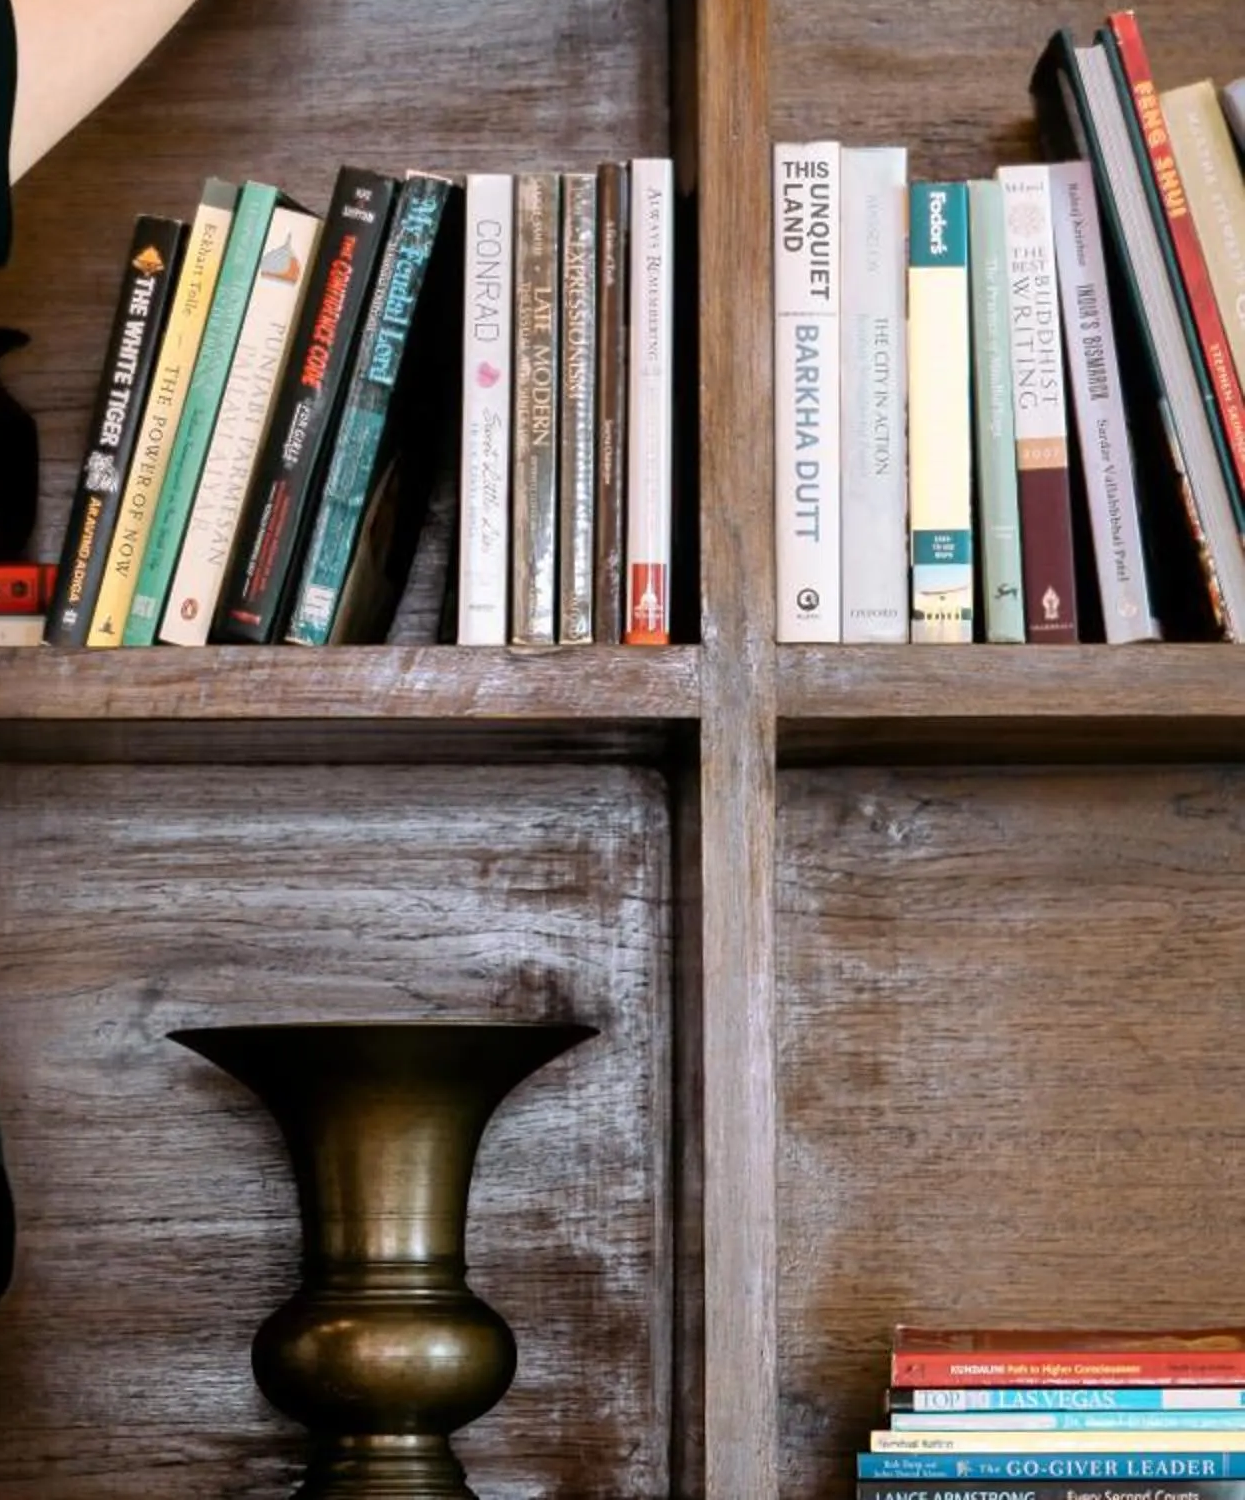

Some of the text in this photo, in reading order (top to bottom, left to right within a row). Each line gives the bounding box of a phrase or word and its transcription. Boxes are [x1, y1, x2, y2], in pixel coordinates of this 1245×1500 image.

[782, 161, 830, 178] THIS
[1132, 79, 1187, 218] FENG SHUI
[194, 222, 218, 276] Eckhart
[402, 195, 437, 237] My
[782, 182, 805, 253] LAND
[809, 182, 831, 301] UNQUIET
[929, 190, 948, 256] Fodor's
[1011, 247, 1046, 259] THE
[182, 280, 203, 318] Tolle
[382, 240, 432, 326] Feudal
[474, 219, 502, 343] CONRAD
[646, 188, 662, 361] ALWAYS REMEMBERING
[1011, 261, 1046, 273] BEST
[368, 325, 406, 386] Lord
[568, 242, 586, 400] EXPRESSIONISM
[1011, 277, 1039, 411] WRITING
[1035, 275, 1058, 407] BUDDHIST
[99, 276, 156, 448] THE WHITE TIGER
[157, 365, 181, 406] THE
[245, 321, 286, 426] PUNJABI
[531, 286, 552, 446] LATE MODERN
[874, 316, 891, 475] THE CITY IN ACTION
[1209, 342, 1234, 404] STEPHEN
[133, 416, 169, 492] POWER
[795, 324, 821, 543] BARKHA DUTT
[128, 491, 149, 523] OF
[207, 434, 255, 567] PARMESAN
[68, 495, 103, 604] ARAVIND ADIGA
[115, 527, 142, 577] NOW
[918, 1390, 1116, 1408] TOP LAS VEGAS
[1006, 1458, 1118, 1477] GO-GIVER
[1127, 1459, 1216, 1477] LEADER
